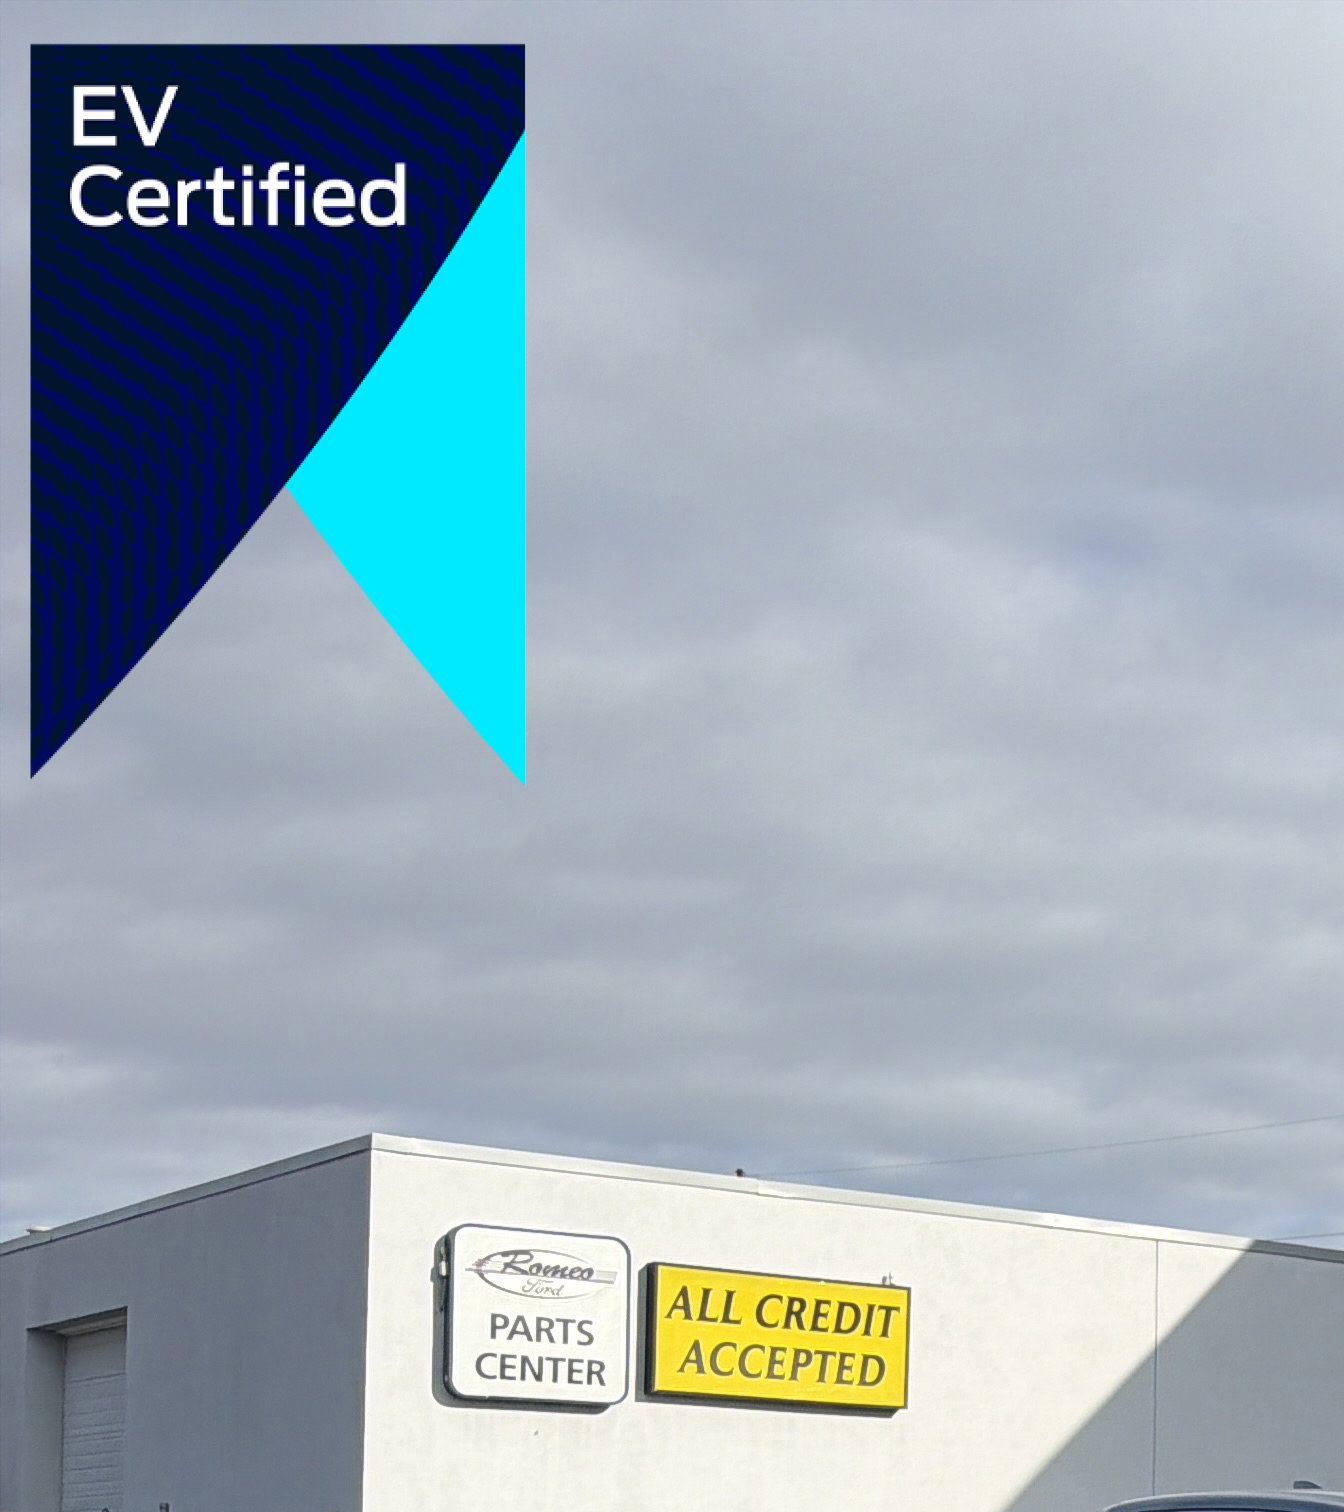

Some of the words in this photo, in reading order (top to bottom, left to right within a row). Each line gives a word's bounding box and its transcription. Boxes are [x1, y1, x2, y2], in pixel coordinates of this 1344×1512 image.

[500, 1250, 595, 1281] Romeo
[521, 1278, 565, 1297] Ford
[665, 1284, 742, 1326] ALL
[755, 1292, 900, 1339] CREDIT
[490, 1312, 595, 1347] PARTS
[475, 1352, 607, 1387] CENTER
[677, 1339, 887, 1388] ACCEPTED
